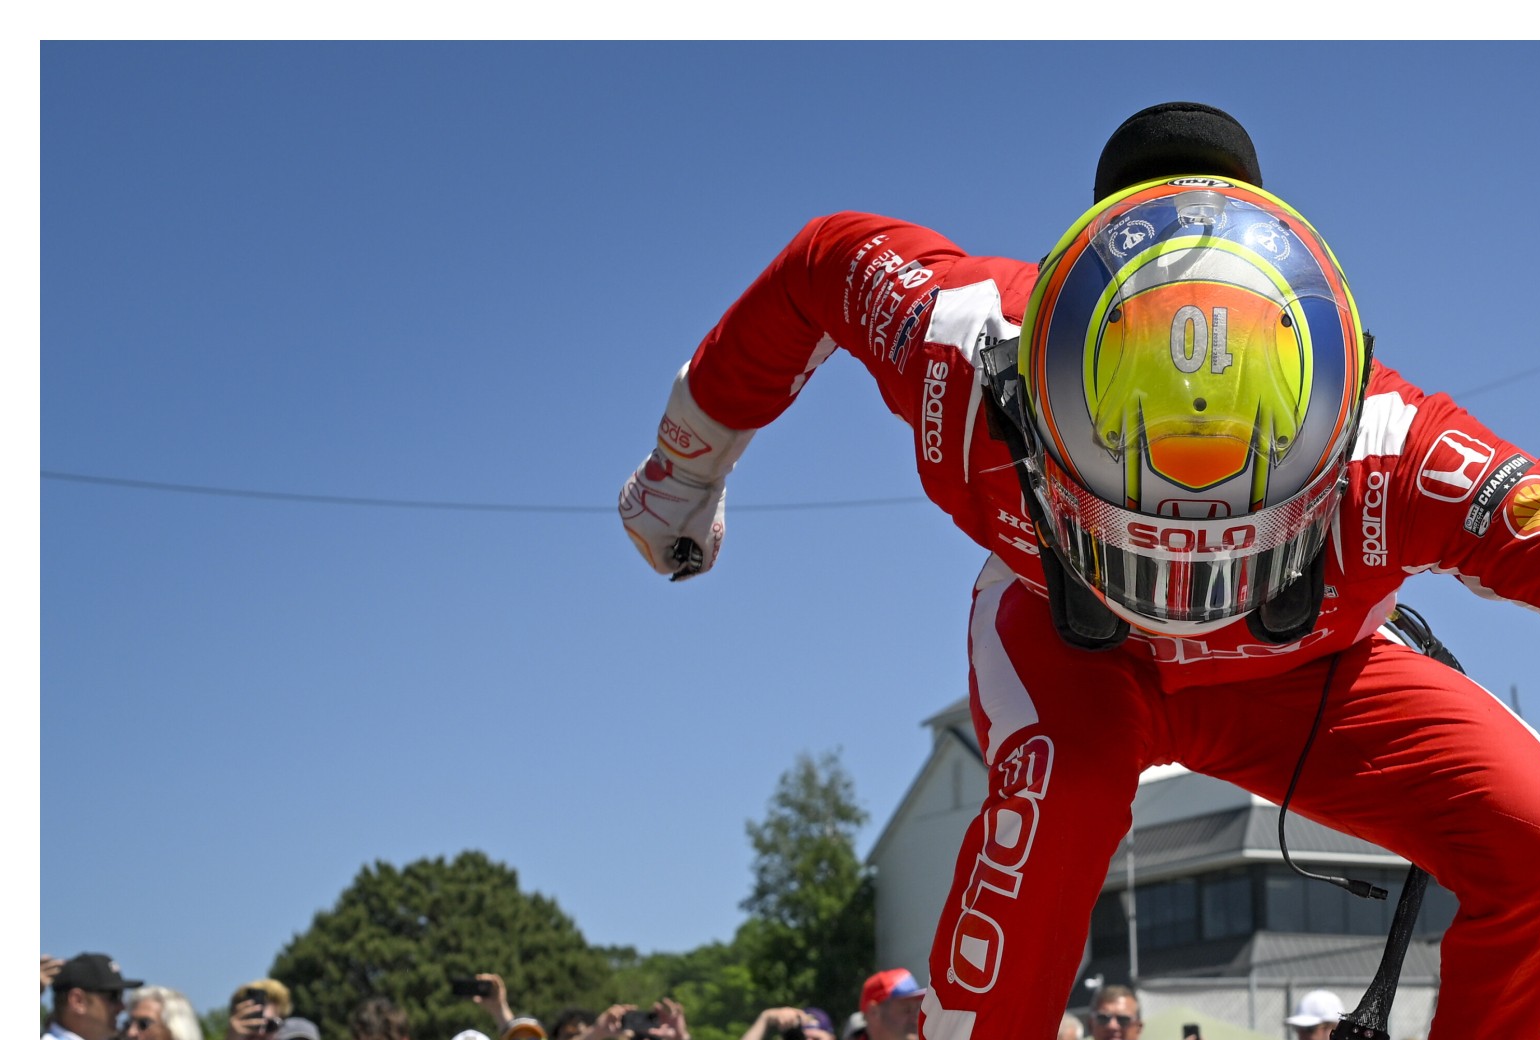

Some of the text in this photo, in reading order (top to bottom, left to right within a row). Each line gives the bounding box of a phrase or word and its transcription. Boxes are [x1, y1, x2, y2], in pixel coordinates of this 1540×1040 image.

[873, 292, 906, 362] PNC
[1170, 304, 1233, 375] 10
[922, 359, 949, 464] sparco
[1478, 456, 1528, 506] CHAMPION
[1127, 521, 1257, 554] SOLO
[1362, 471, 1390, 567] sparco
